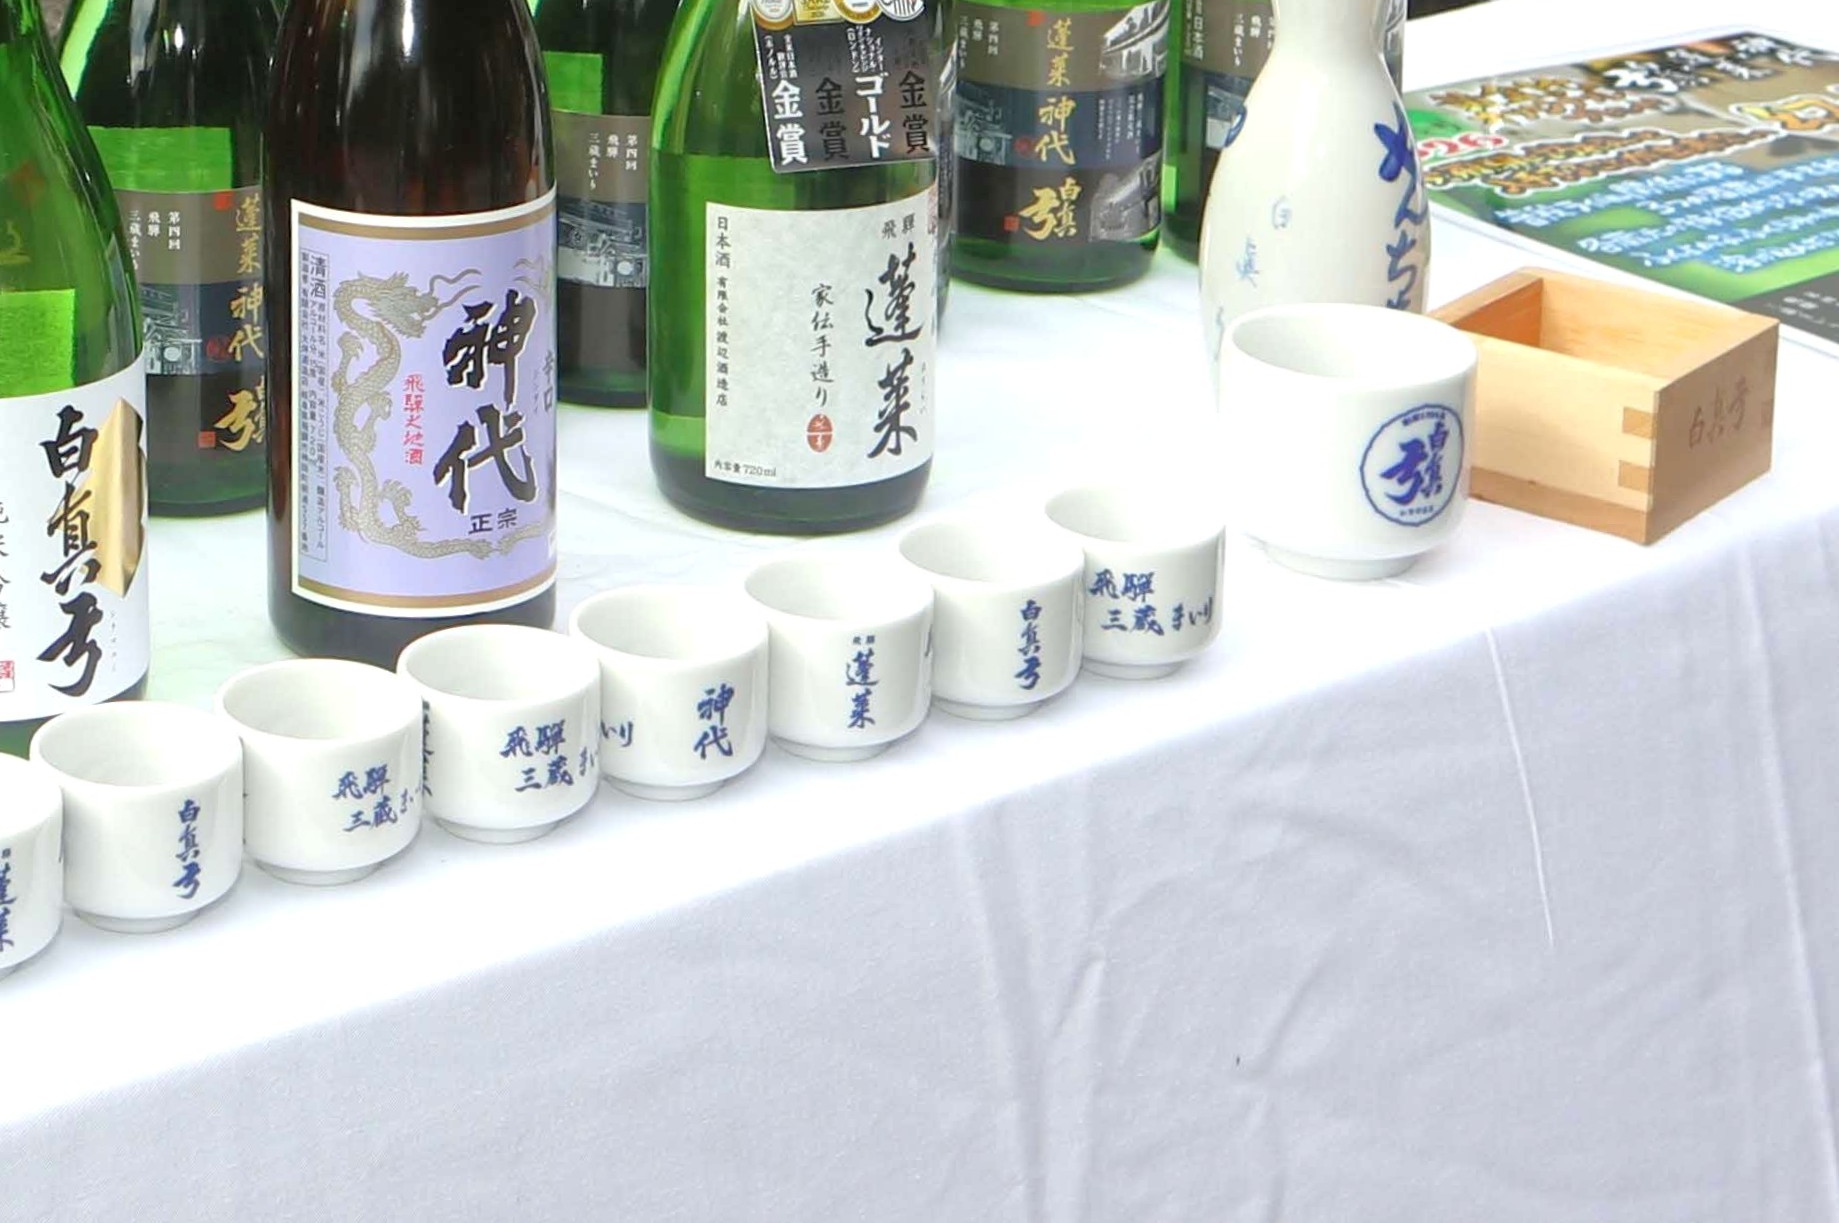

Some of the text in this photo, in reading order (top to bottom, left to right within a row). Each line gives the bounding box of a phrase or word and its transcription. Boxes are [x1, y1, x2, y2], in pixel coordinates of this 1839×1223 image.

[1046, 17, 1075, 88] 蓬莱
[771, 79, 808, 166] 金賞
[815, 77, 849, 162] 金賞
[855, 72, 892, 159] ゴールド
[899, 70, 931, 155] 金賞
[1034, 95, 1077, 165] 神代
[235, 193, 262, 274] 蓬莱
[715, 216, 731, 269] 日本酒
[310, 254, 327, 299] 清酒
[716, 276, 729, 327] 有限会社
[228, 284, 265, 361] 神代
[810, 283, 835, 408] 家伝手造り
[864, 240, 925, 459] 蓬莱
[433, 289, 538, 514] 神代
[36, 404, 104, 697] 白真弓
[468, 509, 520, 536] 正宗
[1014, 599, 1043, 690] 白真弓
[693, 683, 735, 760] 神代
[845, 647, 879, 729] 蓬莱
[172, 798, 202, 900] 白真弓
